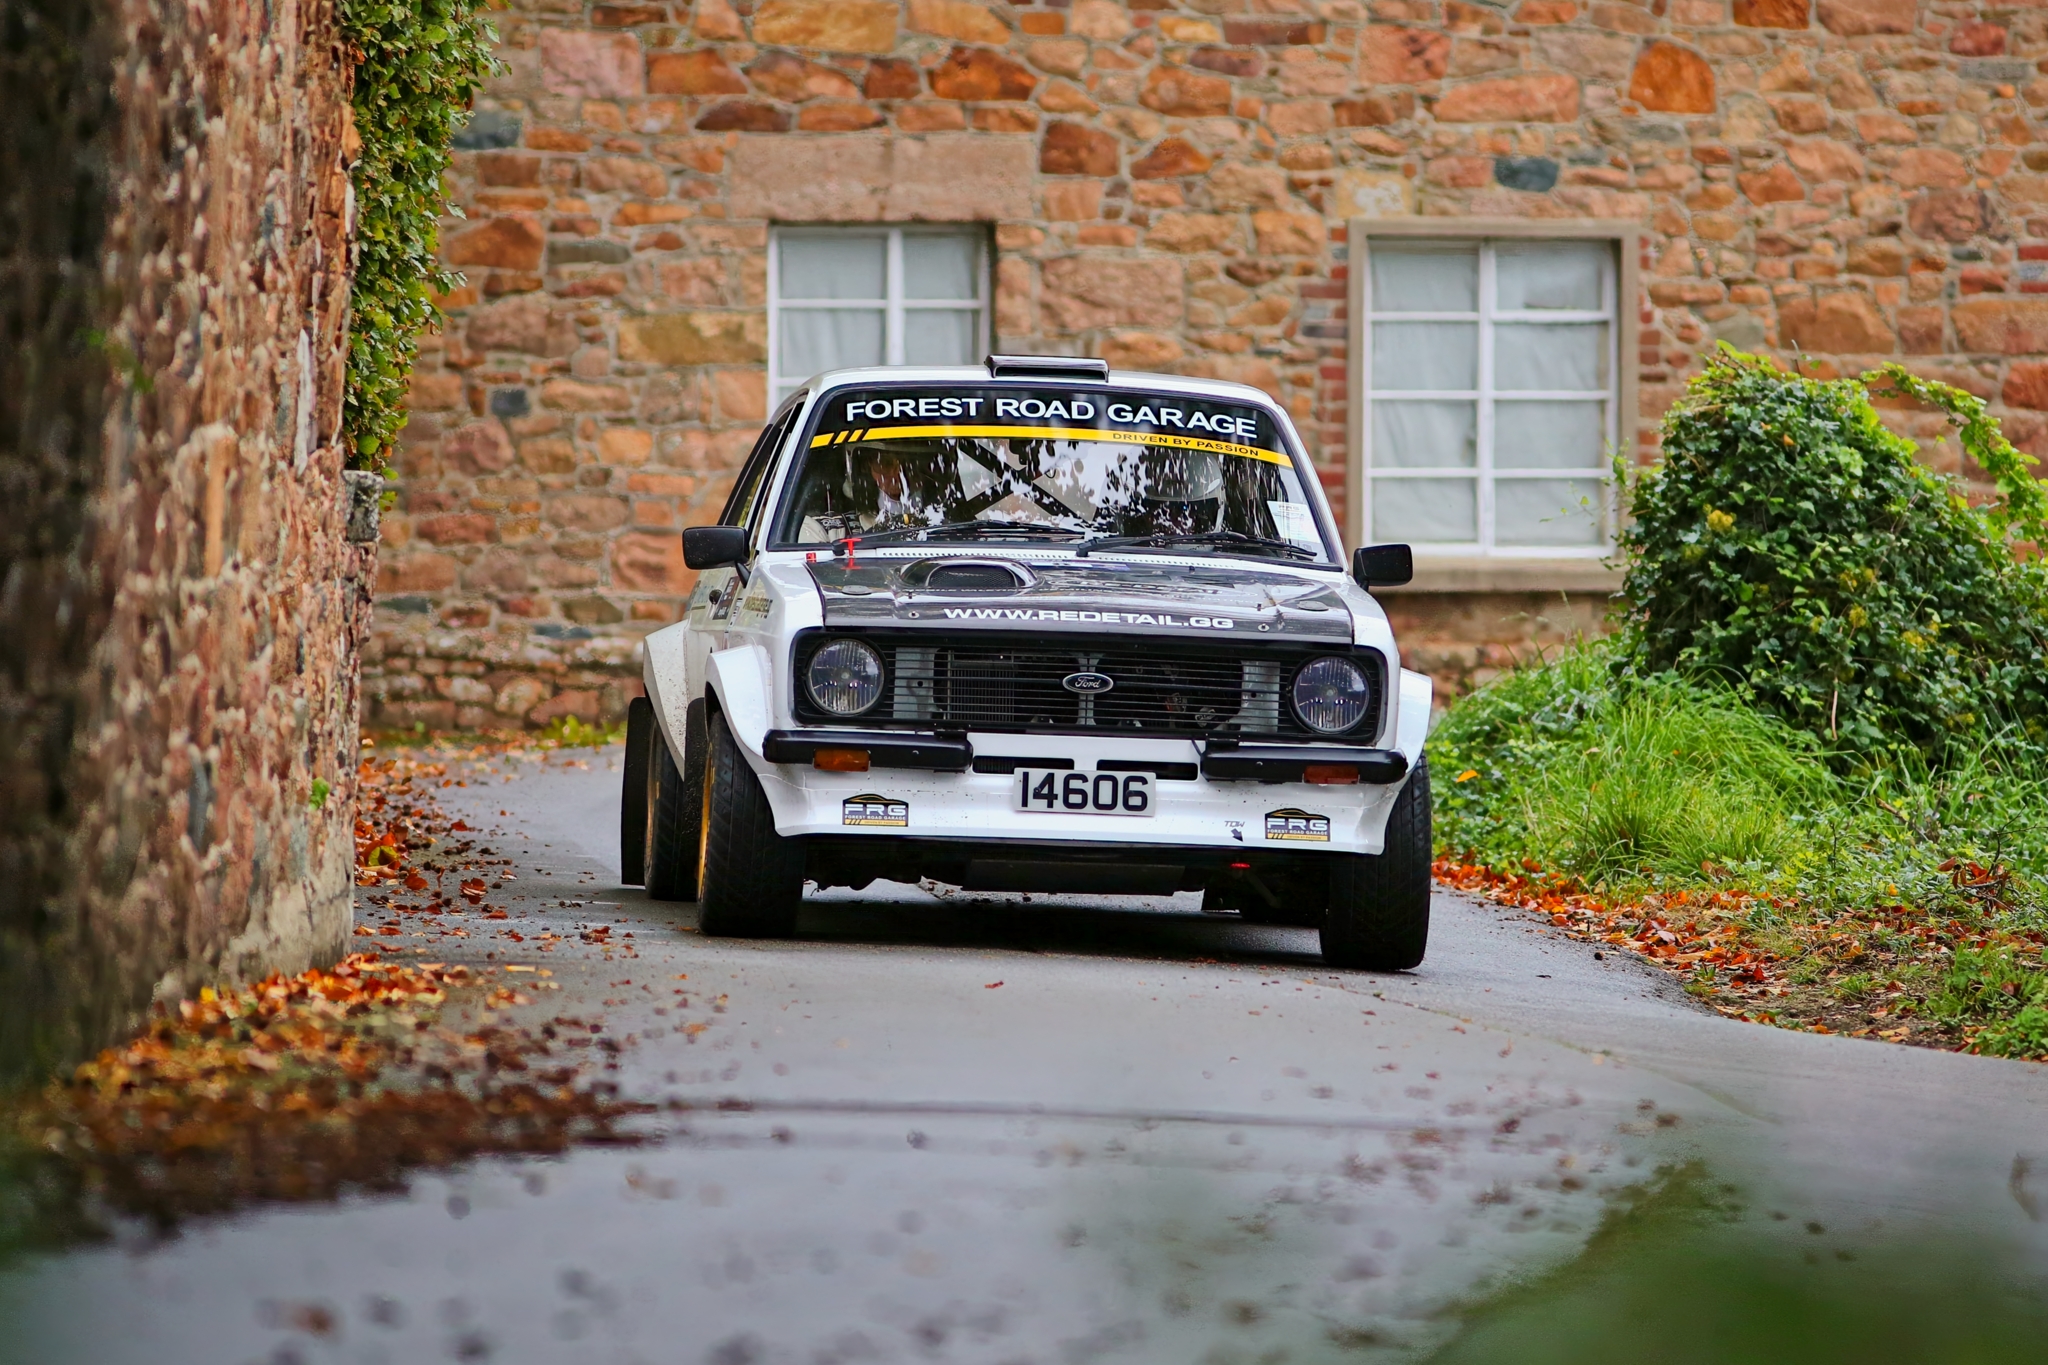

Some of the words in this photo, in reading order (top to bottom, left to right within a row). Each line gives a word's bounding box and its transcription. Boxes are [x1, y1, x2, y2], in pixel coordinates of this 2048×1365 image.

[846, 397, 984, 422] FOREST
[996, 399, 1095, 420] ROAD
[1107, 402, 1258, 439] GARAGE
[1112, 432, 1168, 444] DRIVEN
[1173, 438, 1191, 446] BY
[1196, 441, 1259, 457] PASSION
[943, 608, 1234, 629] WWW.REDETAIL.GG
[1074, 675, 1102, 688] Ford
[1021, 771, 1149, 812] 14606
[845, 804, 906, 816] FRG
[1267, 818, 1327, 831] FRG
